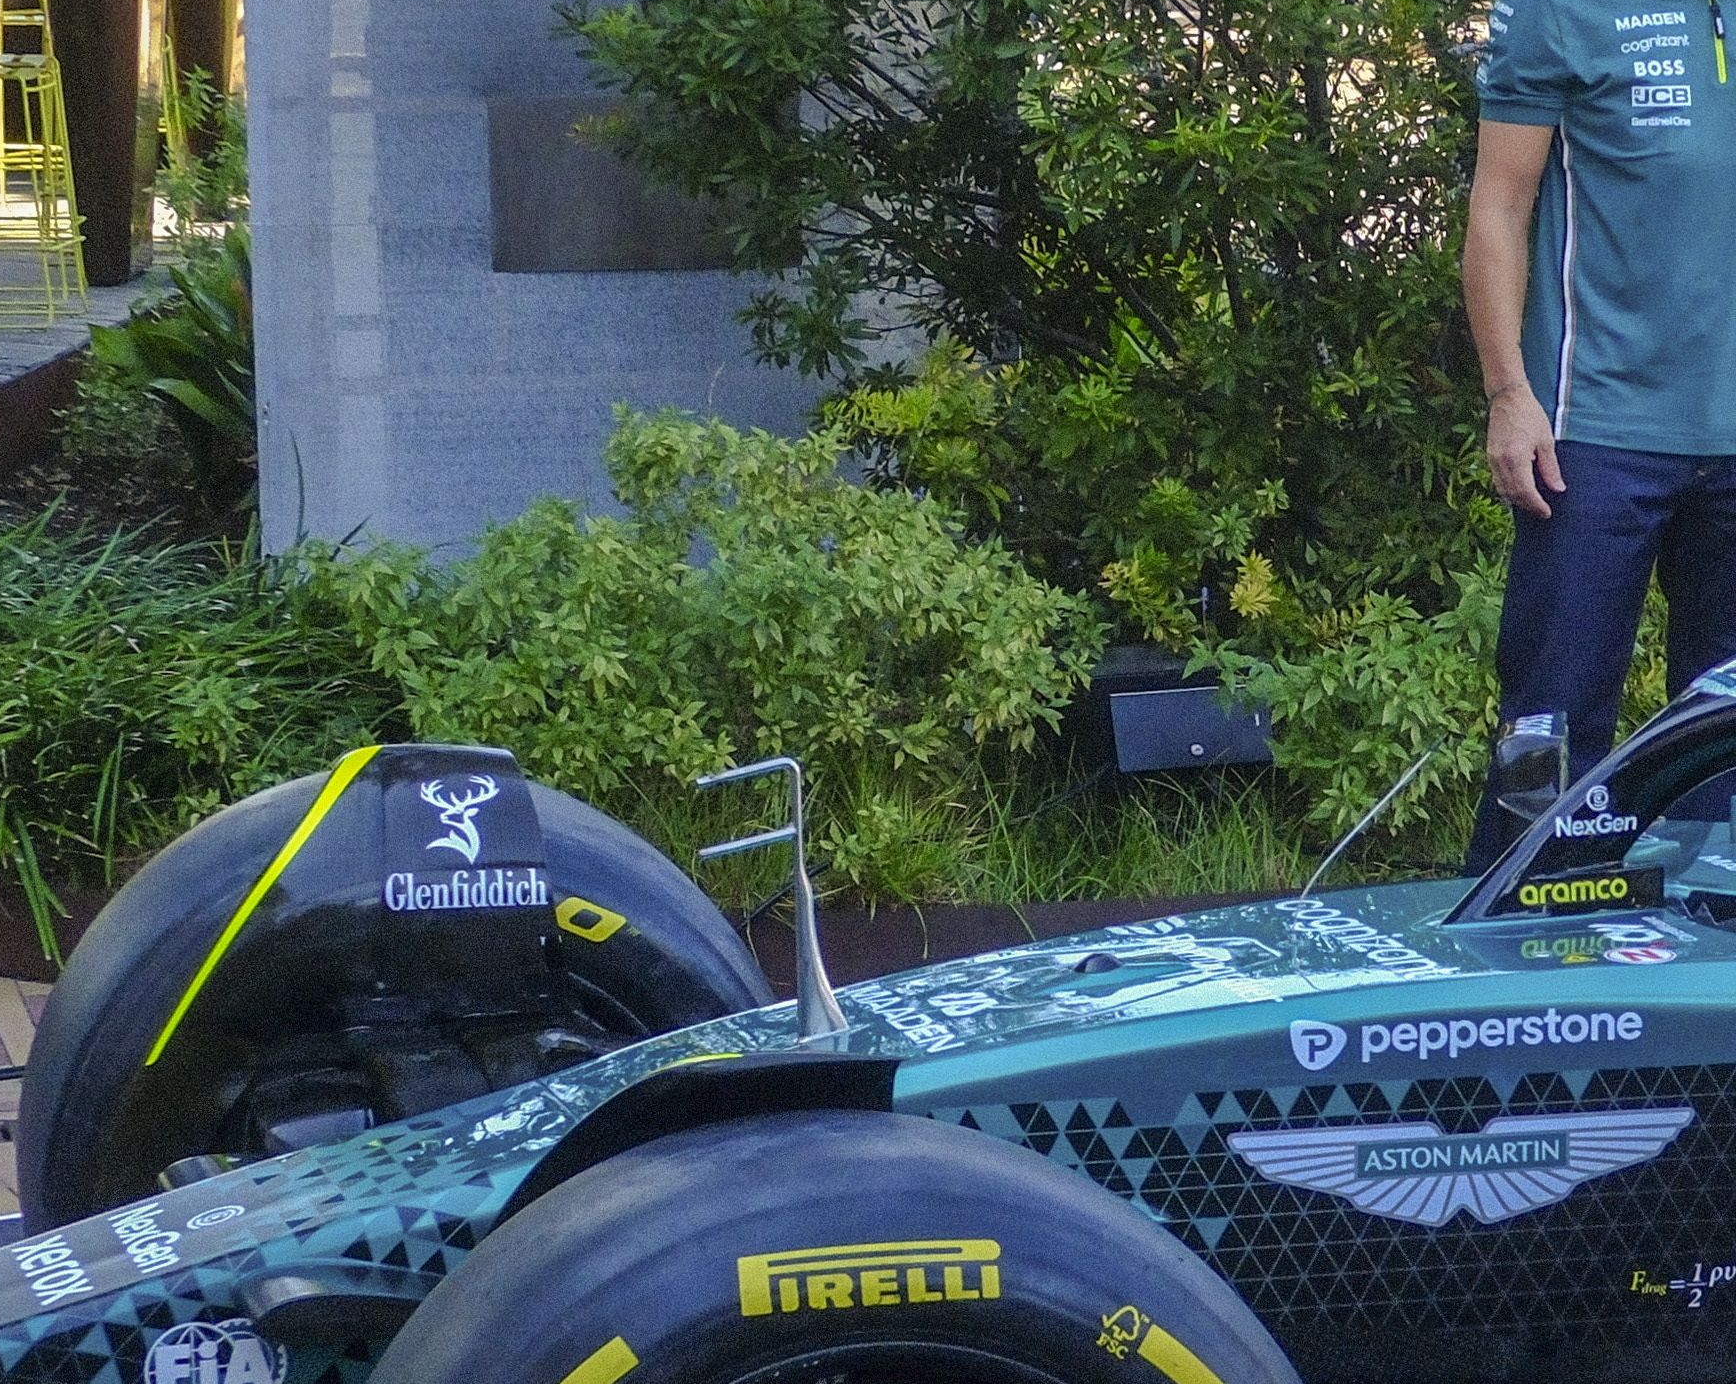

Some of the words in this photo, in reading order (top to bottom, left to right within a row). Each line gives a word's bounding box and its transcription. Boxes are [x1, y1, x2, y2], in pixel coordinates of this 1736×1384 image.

[1615, 12, 1686, 32] MAADEN
[1620, 33, 1690, 54] cognizant
[1633, 60, 1686, 77] BOSS
[1634, 87, 1690, 105] JCB
[1554, 814, 1638, 839] NexGen
[383, 867, 550, 913] Glenfiddich
[1519, 876, 1628, 907] aramco
[1361, 1006, 1644, 1064] pepperstone
[1364, 1145, 1452, 1173] ASTON
[1458, 1138, 1562, 1168] MARTIN
[107, 1201, 182, 1275] NexGen
[11, 1233, 95, 1307] xerox
[736, 1237, 1003, 1318] PIRELLI
[1095, 1331, 1129, 1360] FSC
